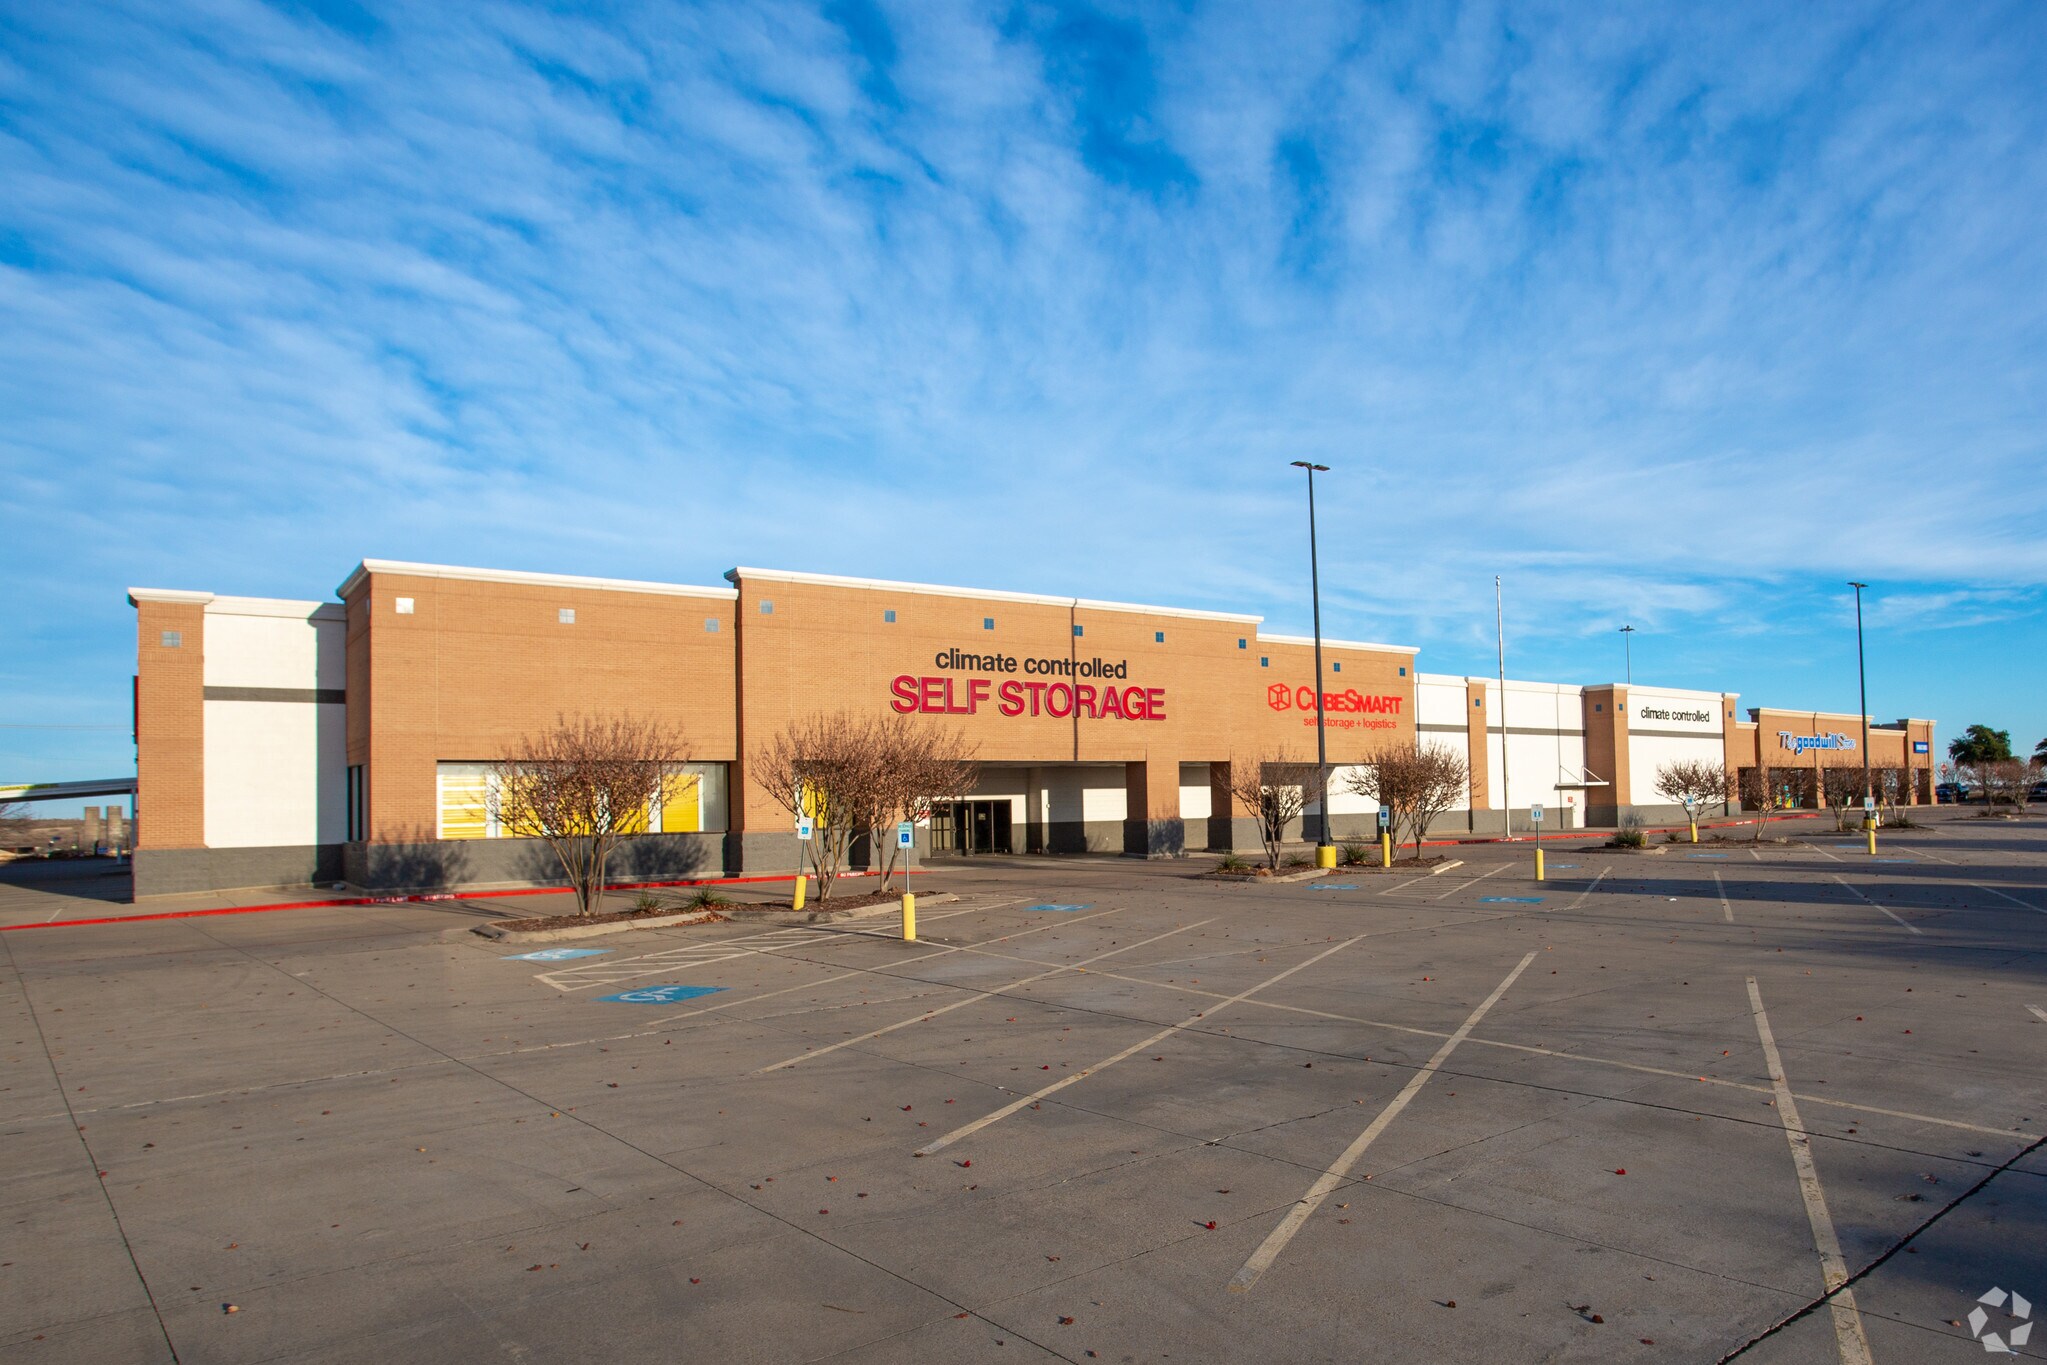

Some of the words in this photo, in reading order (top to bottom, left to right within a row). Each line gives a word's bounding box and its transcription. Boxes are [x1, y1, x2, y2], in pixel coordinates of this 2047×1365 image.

[935, 648, 1017, 673] climate
[1024, 657, 1127, 679] controlled
[890, 675, 991, 714] SELF
[998, 680, 1166, 720] STORAGE
[1363, 718, 1397, 731] logistics
[1640, 706, 1670, 721] climate
[1671, 710, 1710, 722] controlled
[1796, 732, 1837, 755] goodwill
